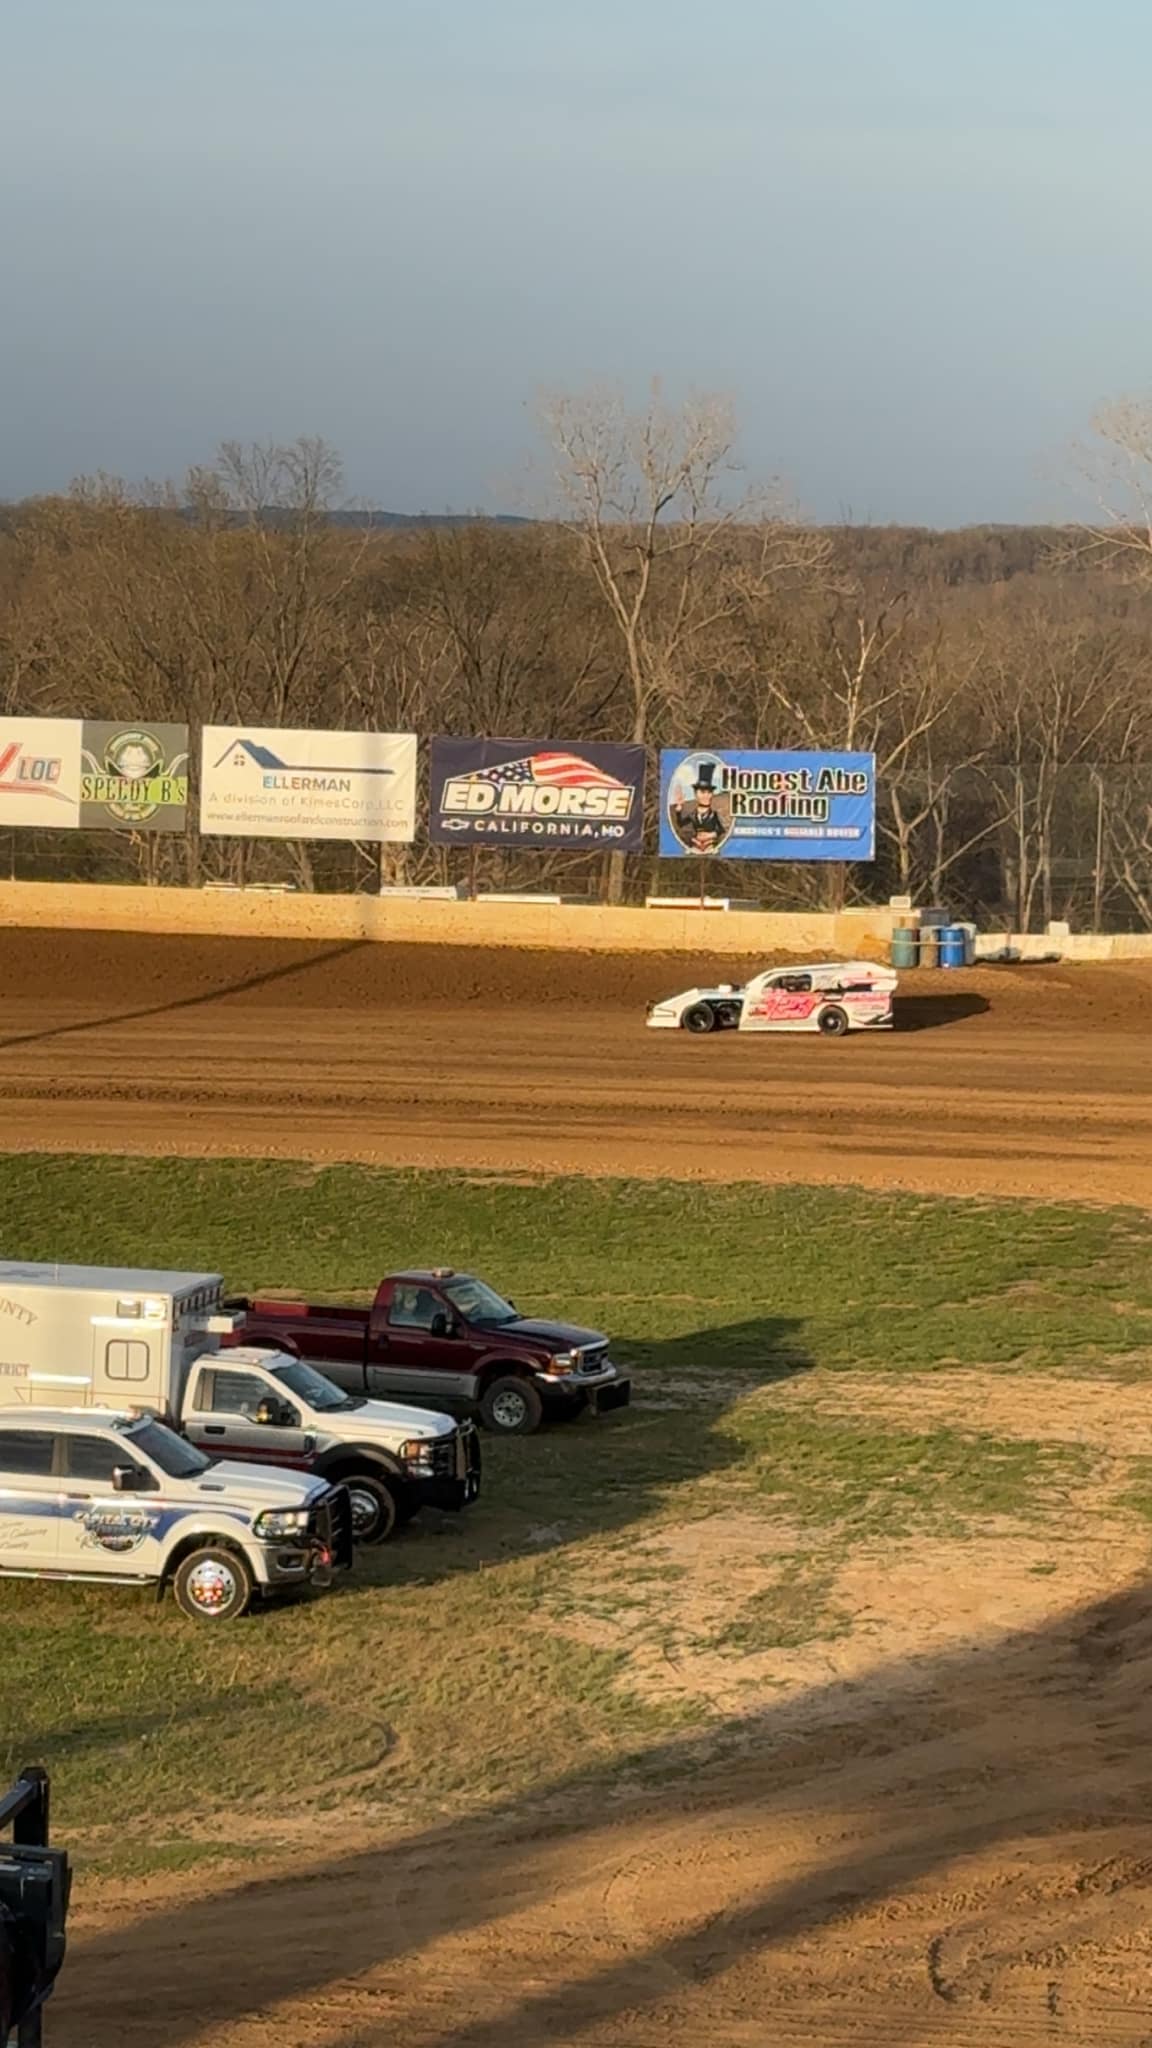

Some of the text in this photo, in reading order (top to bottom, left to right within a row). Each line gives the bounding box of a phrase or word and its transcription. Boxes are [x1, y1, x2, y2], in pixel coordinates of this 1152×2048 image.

[81, 776, 150, 801] SPEEDY
[262, 775, 351, 793] ELLERMAN
[721, 766, 867, 794] Honest Abe
[208, 792, 218, 803] A
[223, 793, 277, 806] division
[282, 796, 295, 807] of
[443, 781, 631, 817] ED MORSE
[730, 791, 829, 822] Roofing
[601, 824, 625, 837] MO
[0, 1299, 38, 1326] NTY
